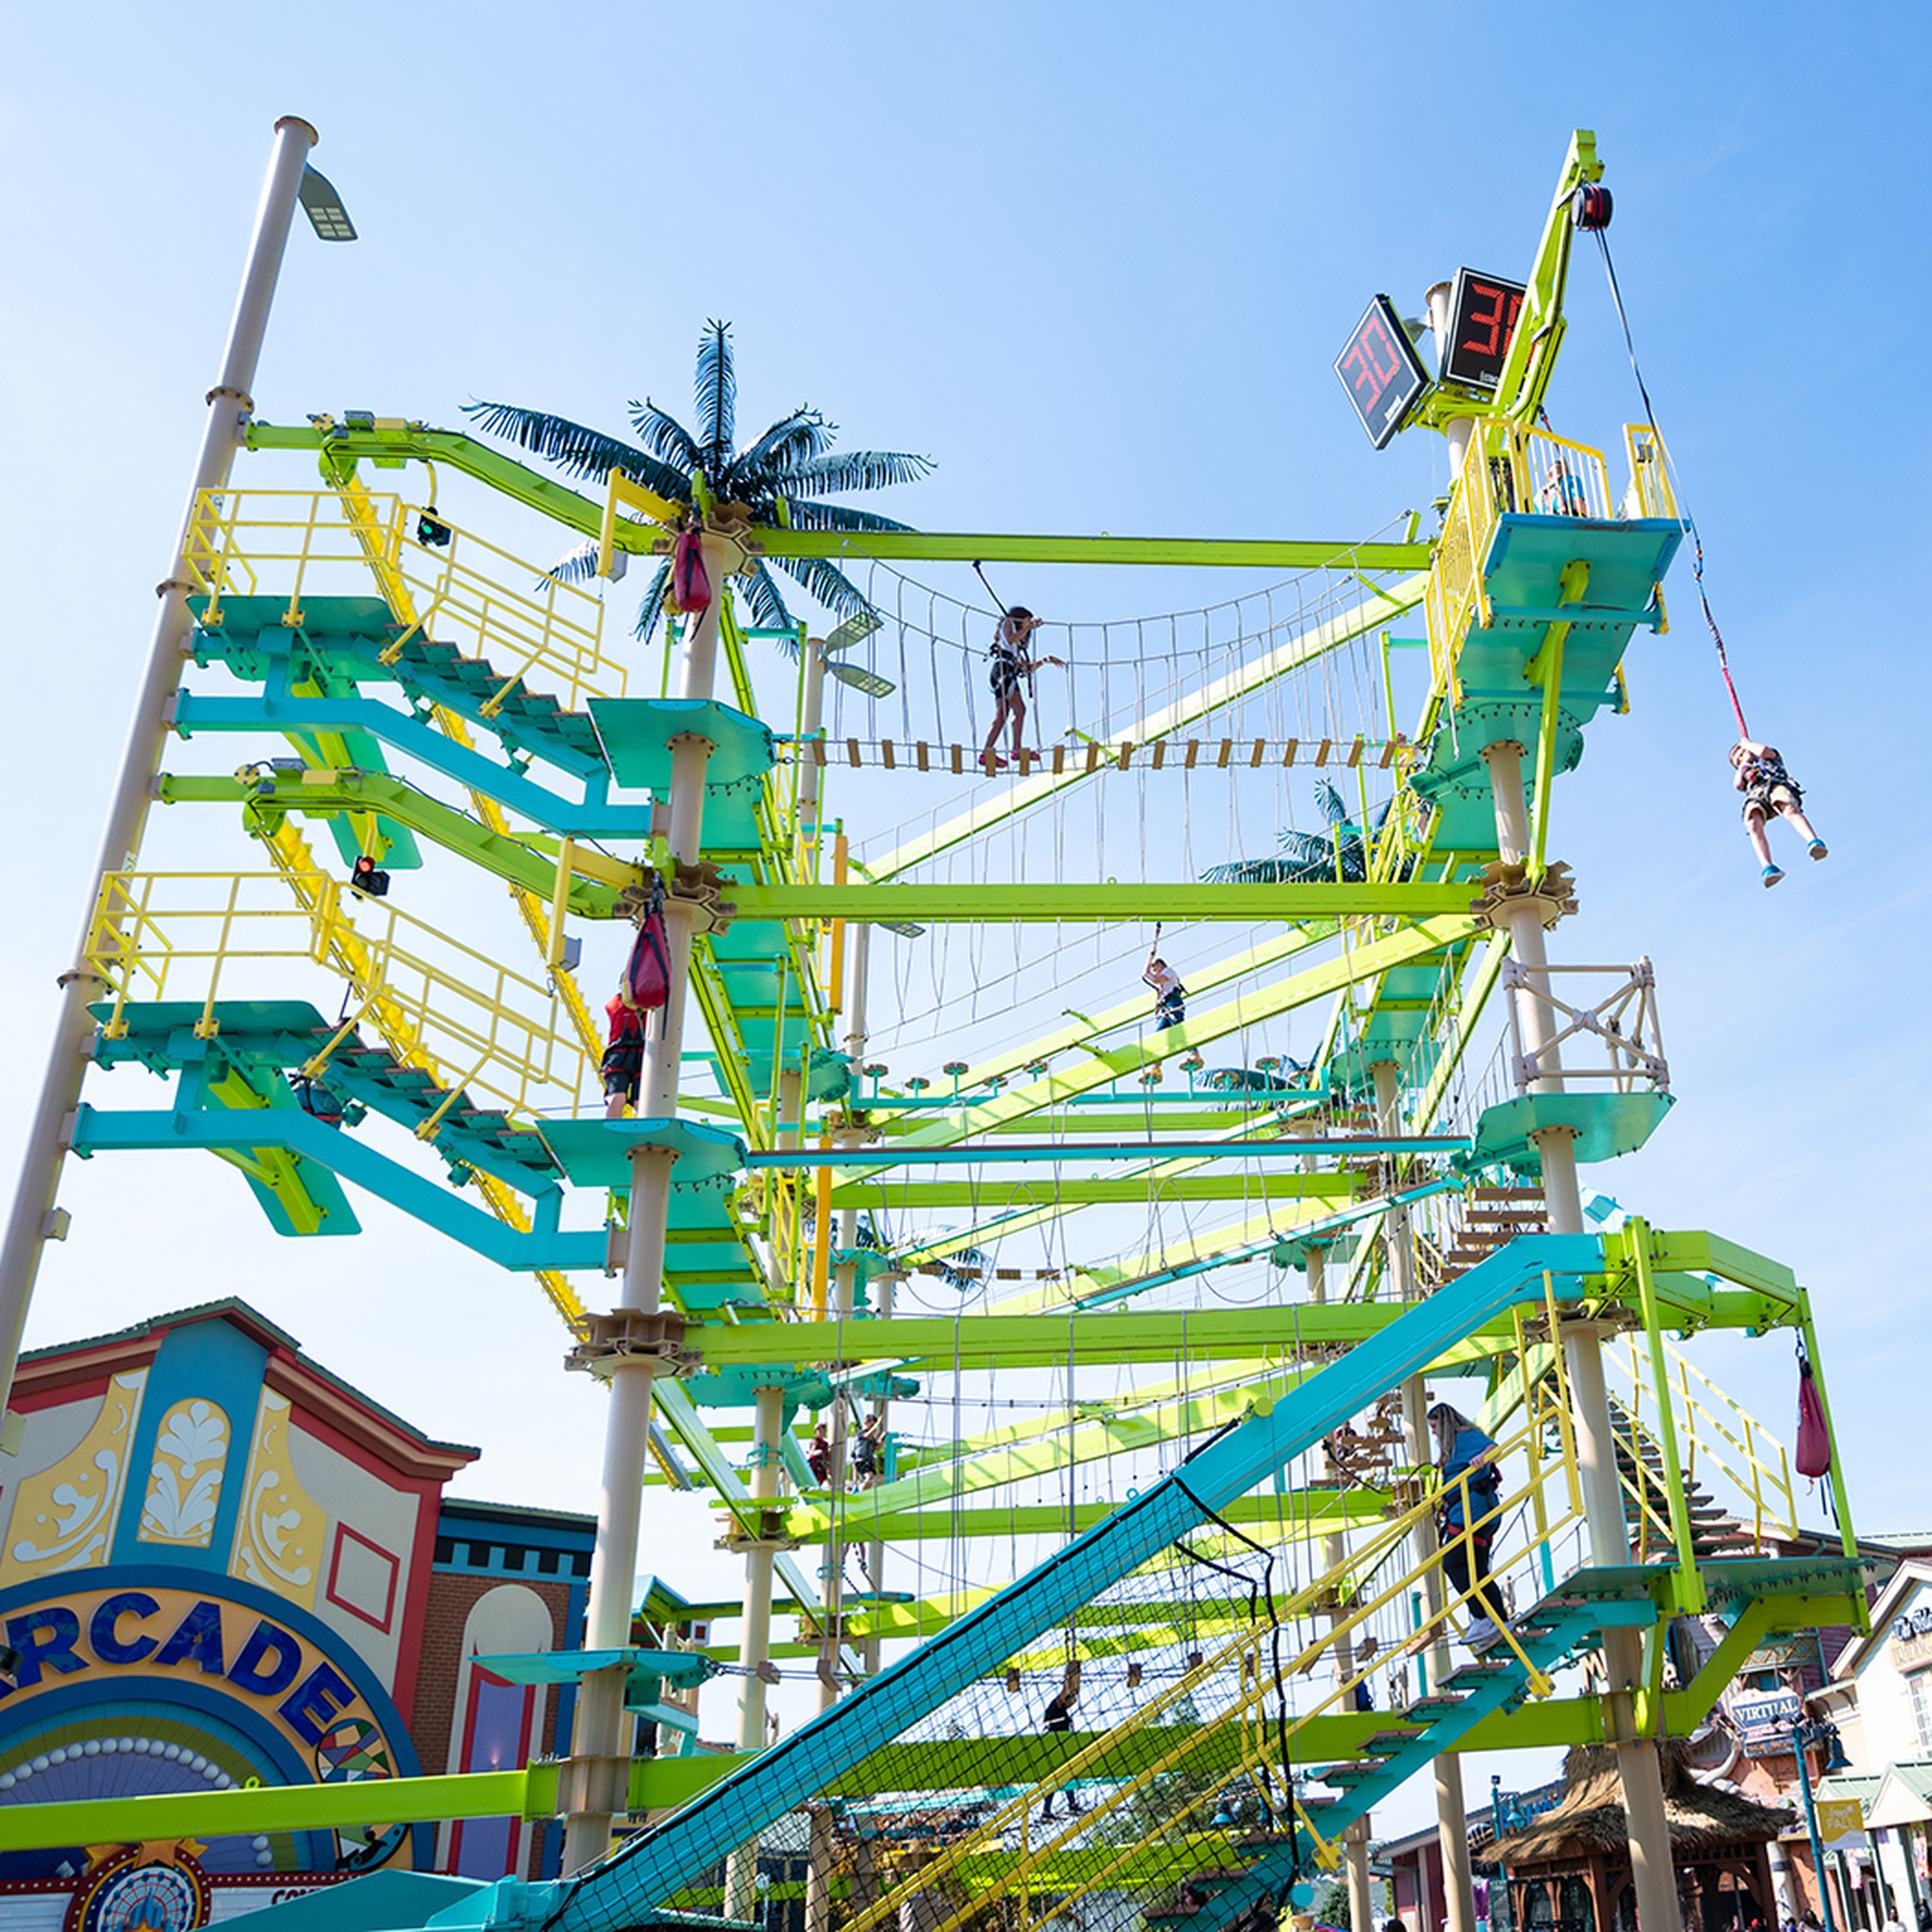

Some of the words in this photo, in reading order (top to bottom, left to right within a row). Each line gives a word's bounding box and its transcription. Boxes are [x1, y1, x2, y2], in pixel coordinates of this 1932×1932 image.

[1342, 313, 1402, 416] 30
[0, 1591, 358, 1748] RCADE
[1735, 1698, 1799, 1721] VIRTUAL
[1826, 1818, 1856, 1830] FALL
